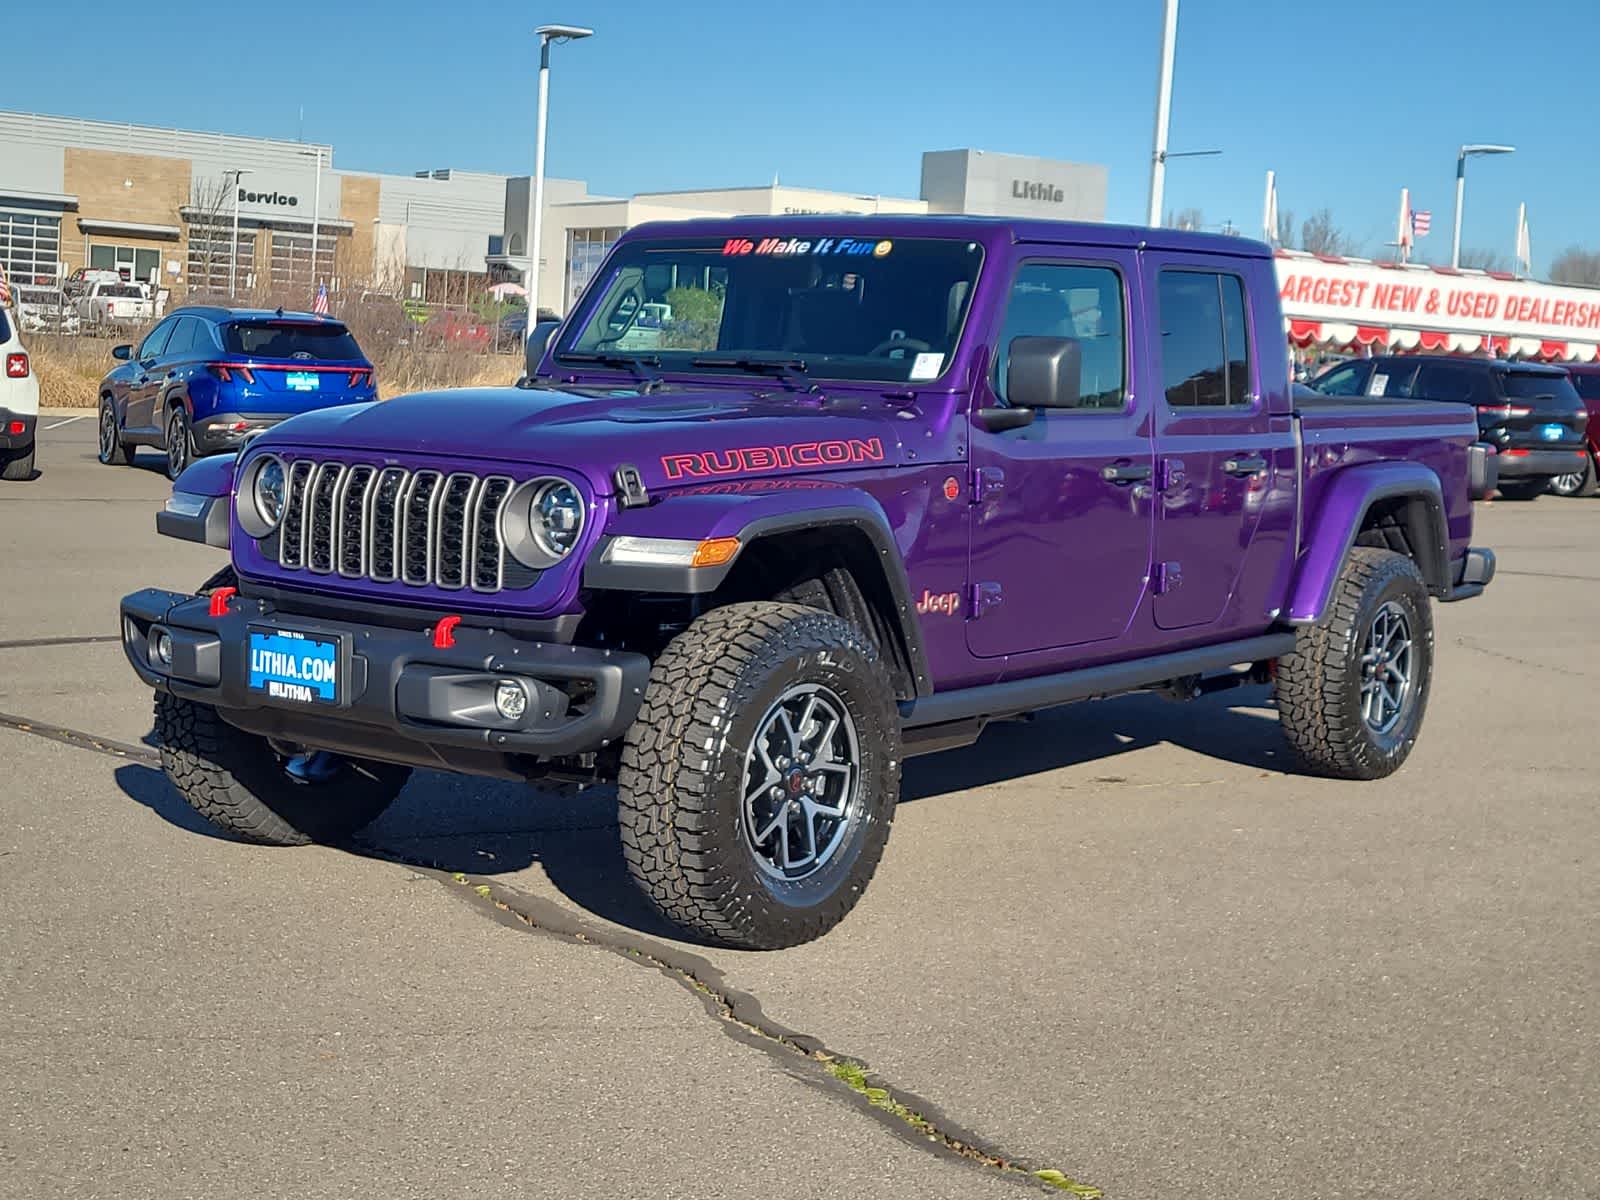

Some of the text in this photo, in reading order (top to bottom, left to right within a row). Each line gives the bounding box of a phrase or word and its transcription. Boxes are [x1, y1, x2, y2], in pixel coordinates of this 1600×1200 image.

[238, 188, 298, 207] Service
[1012, 179, 1064, 203] Lithia
[721, 238, 876, 256] We Make It Fun
[1279, 274, 1369, 308] ARGEST
[1371, 281, 1423, 313] NEW
[1425, 287, 1440, 314] &
[1447, 290, 1499, 319] USED
[660, 437, 885, 481] RUBICON
[915, 589, 960, 616] Jeep
[251, 648, 336, 684] LITHIA.COM
